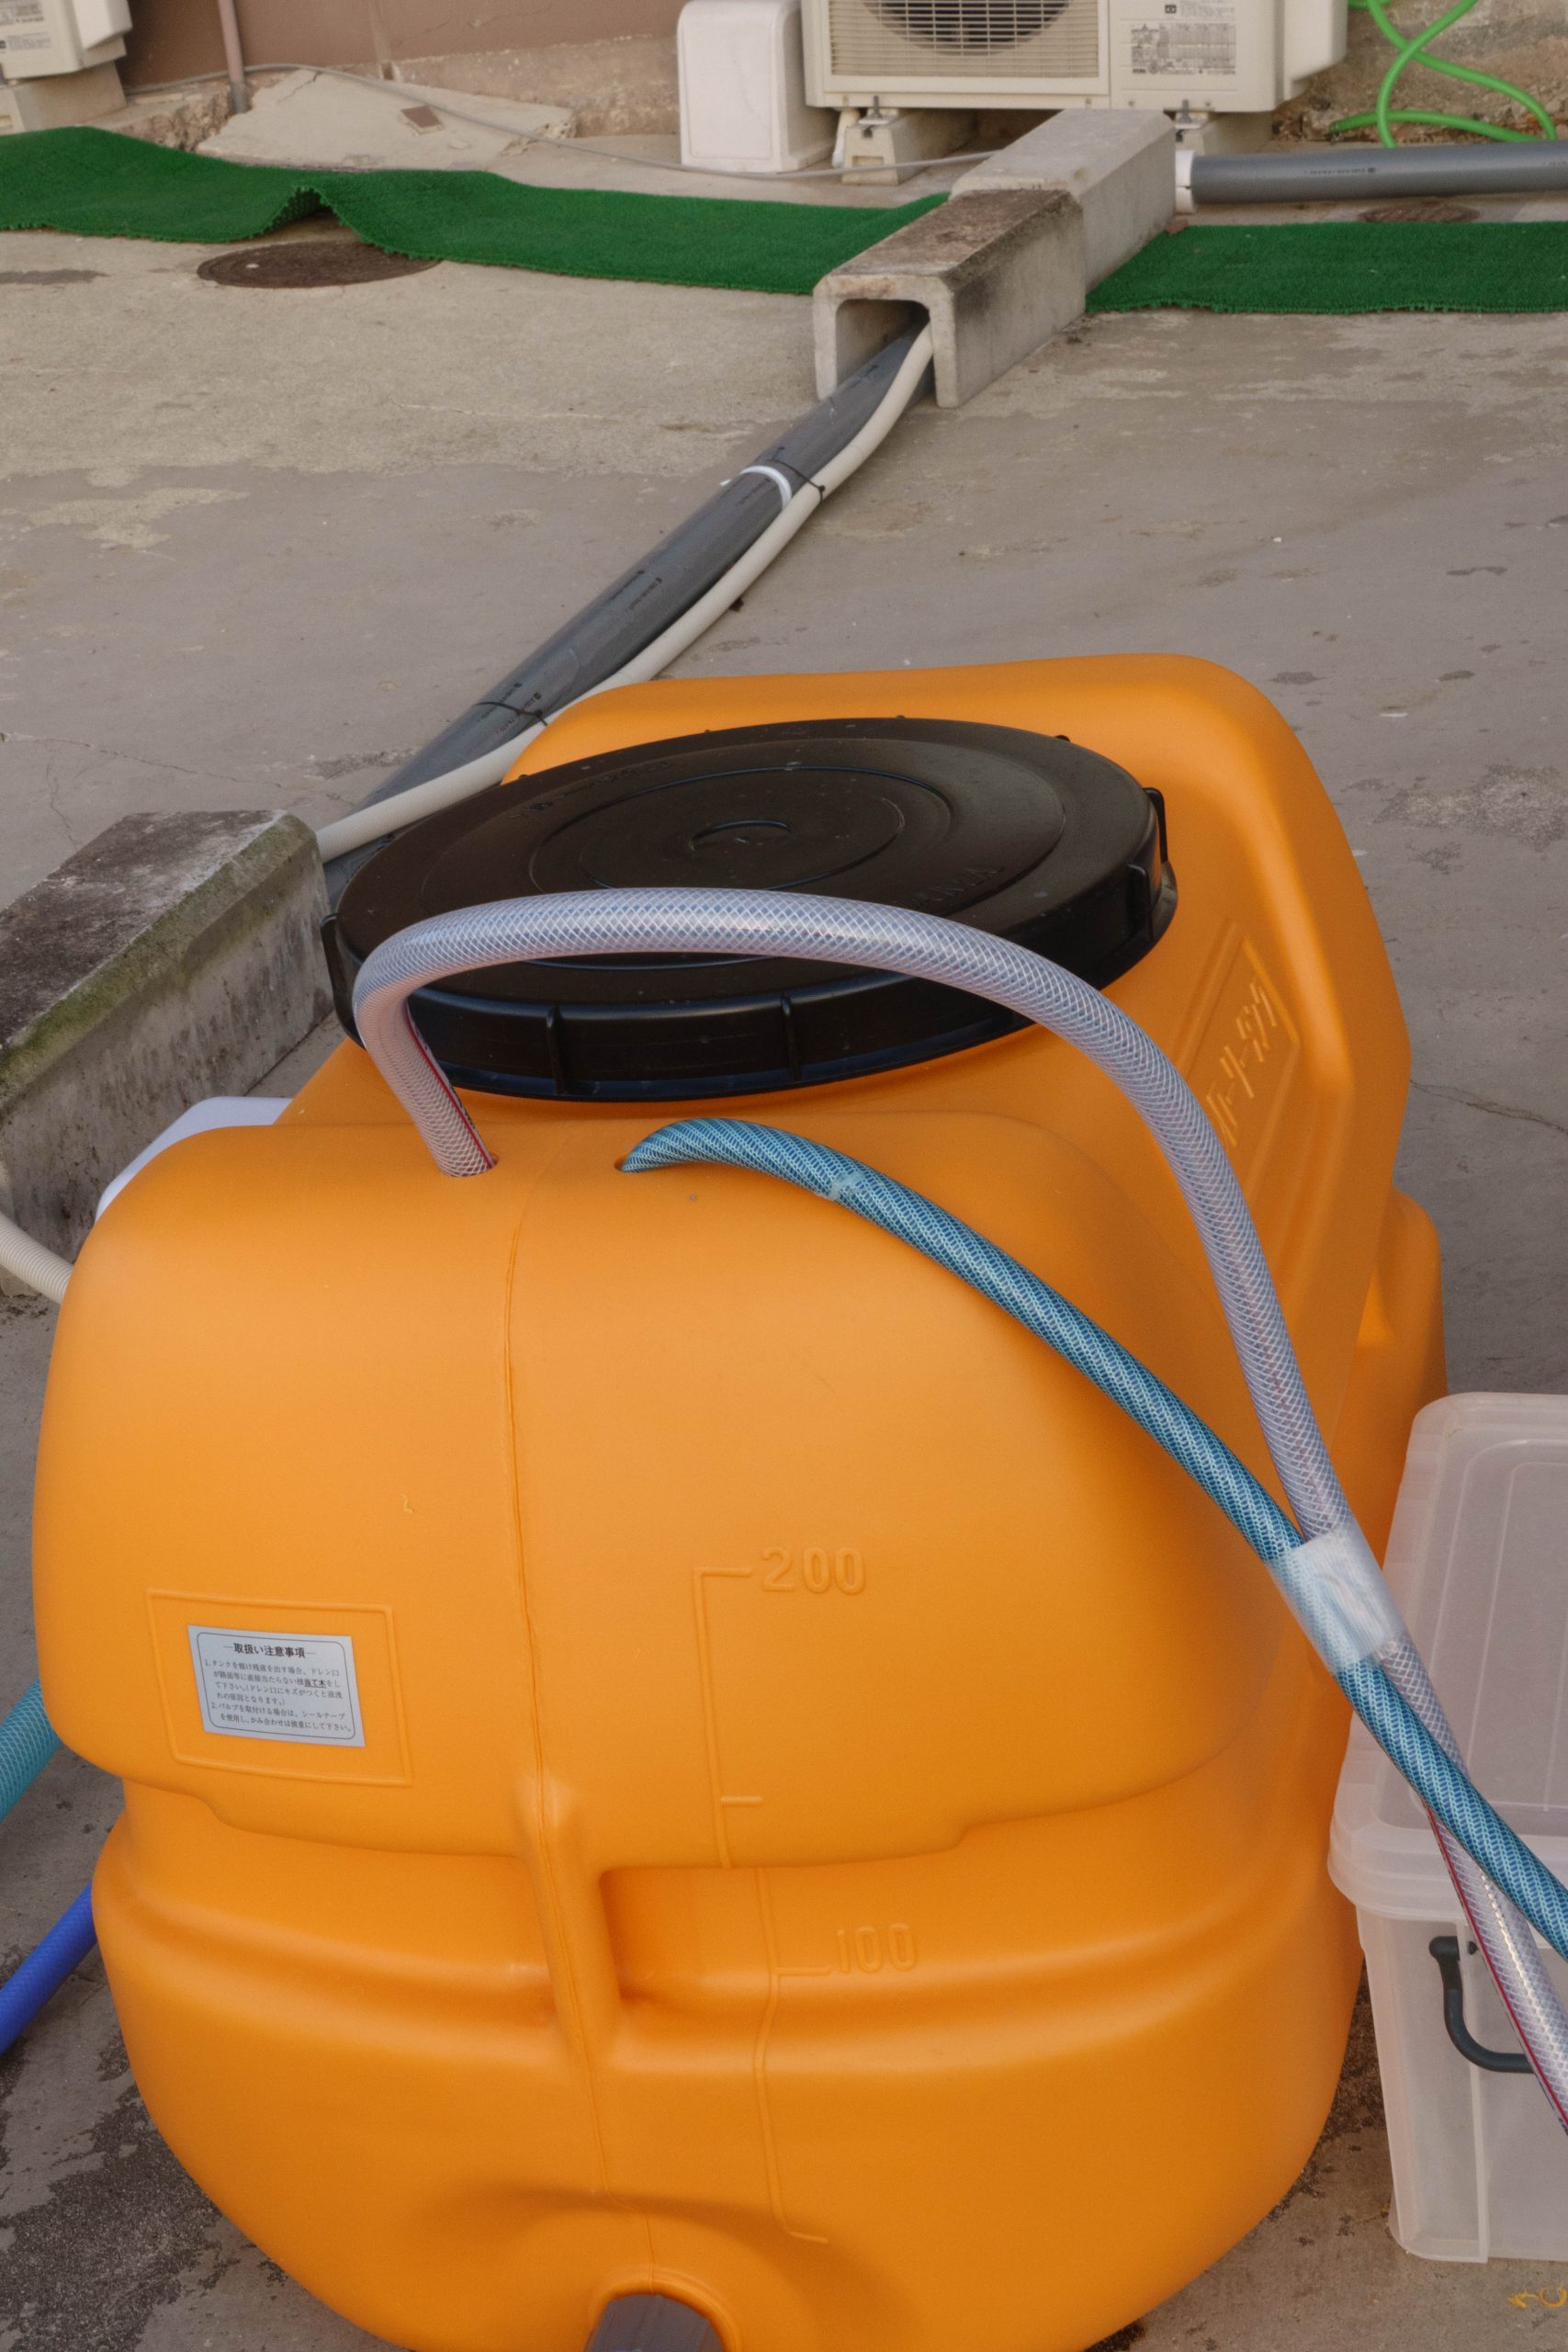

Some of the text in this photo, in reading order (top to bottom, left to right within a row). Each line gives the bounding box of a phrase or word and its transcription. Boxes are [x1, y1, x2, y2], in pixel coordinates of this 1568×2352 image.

[761, 1546, 866, 1596] 200
[233, 1643, 307, 1658] 取扱い注意事項
[837, 1922, 917, 1974] 100
